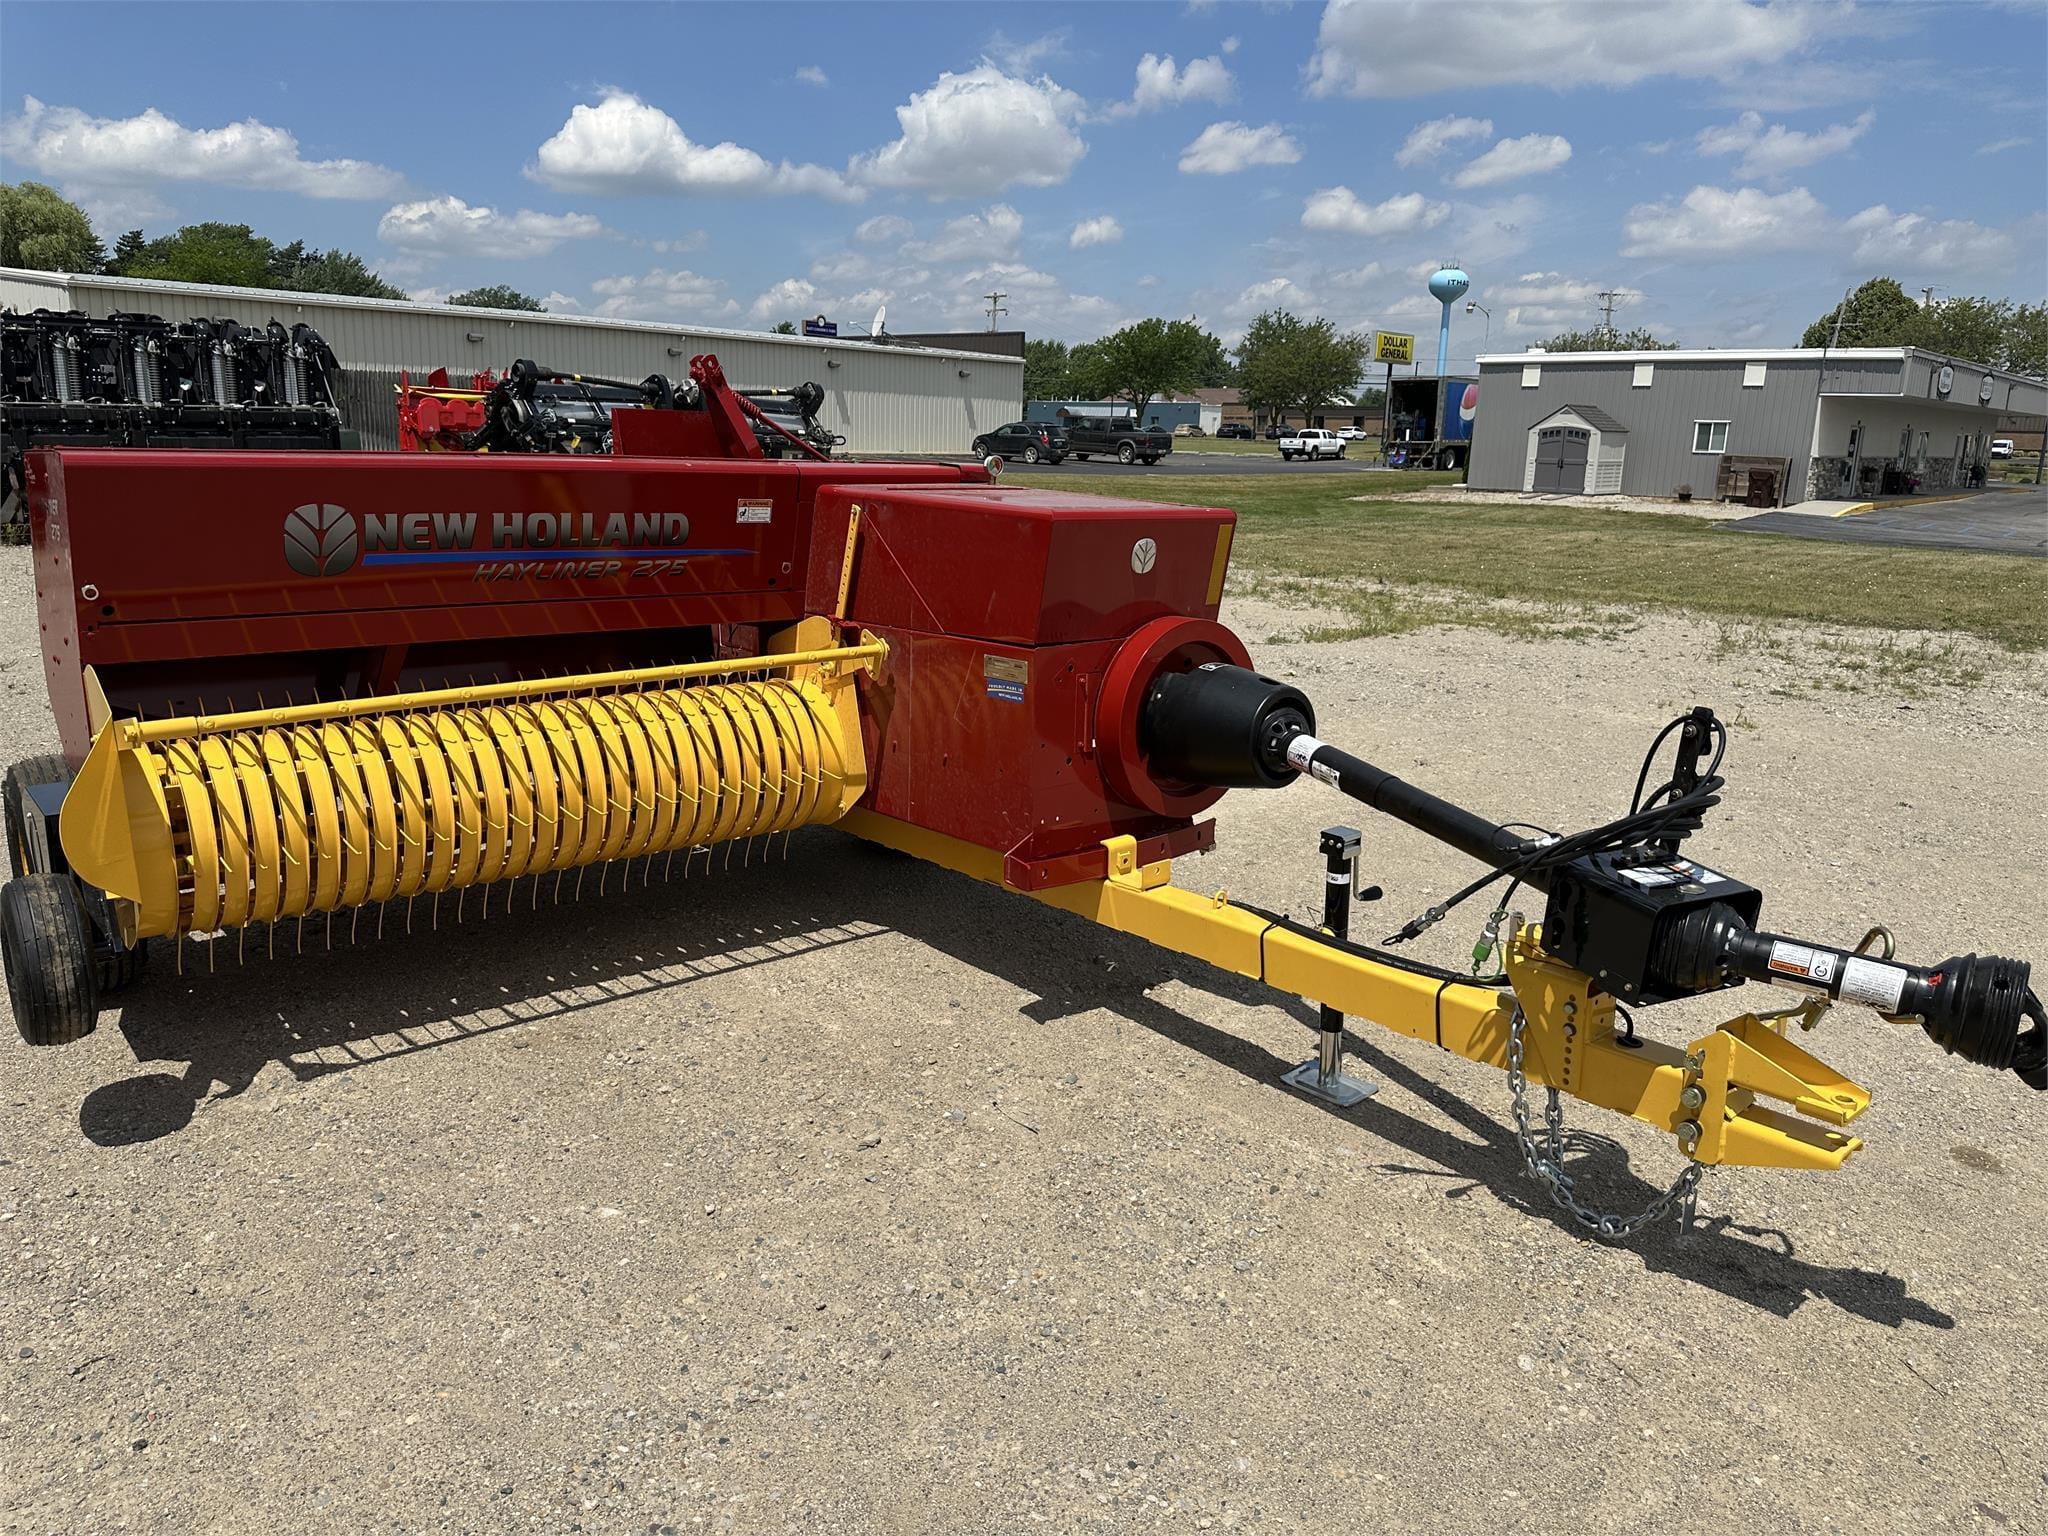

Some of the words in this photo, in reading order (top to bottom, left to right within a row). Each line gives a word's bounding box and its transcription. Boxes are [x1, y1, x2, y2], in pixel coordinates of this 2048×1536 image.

[1382, 335, 1408, 349] DOLLAR
[1380, 347, 1409, 361] GENERAL
[363, 512, 478, 551] NEW
[491, 512, 690, 550] HOLLAND
[472, 560, 622, 582] HAYLINER
[630, 559, 689, 577] 275
